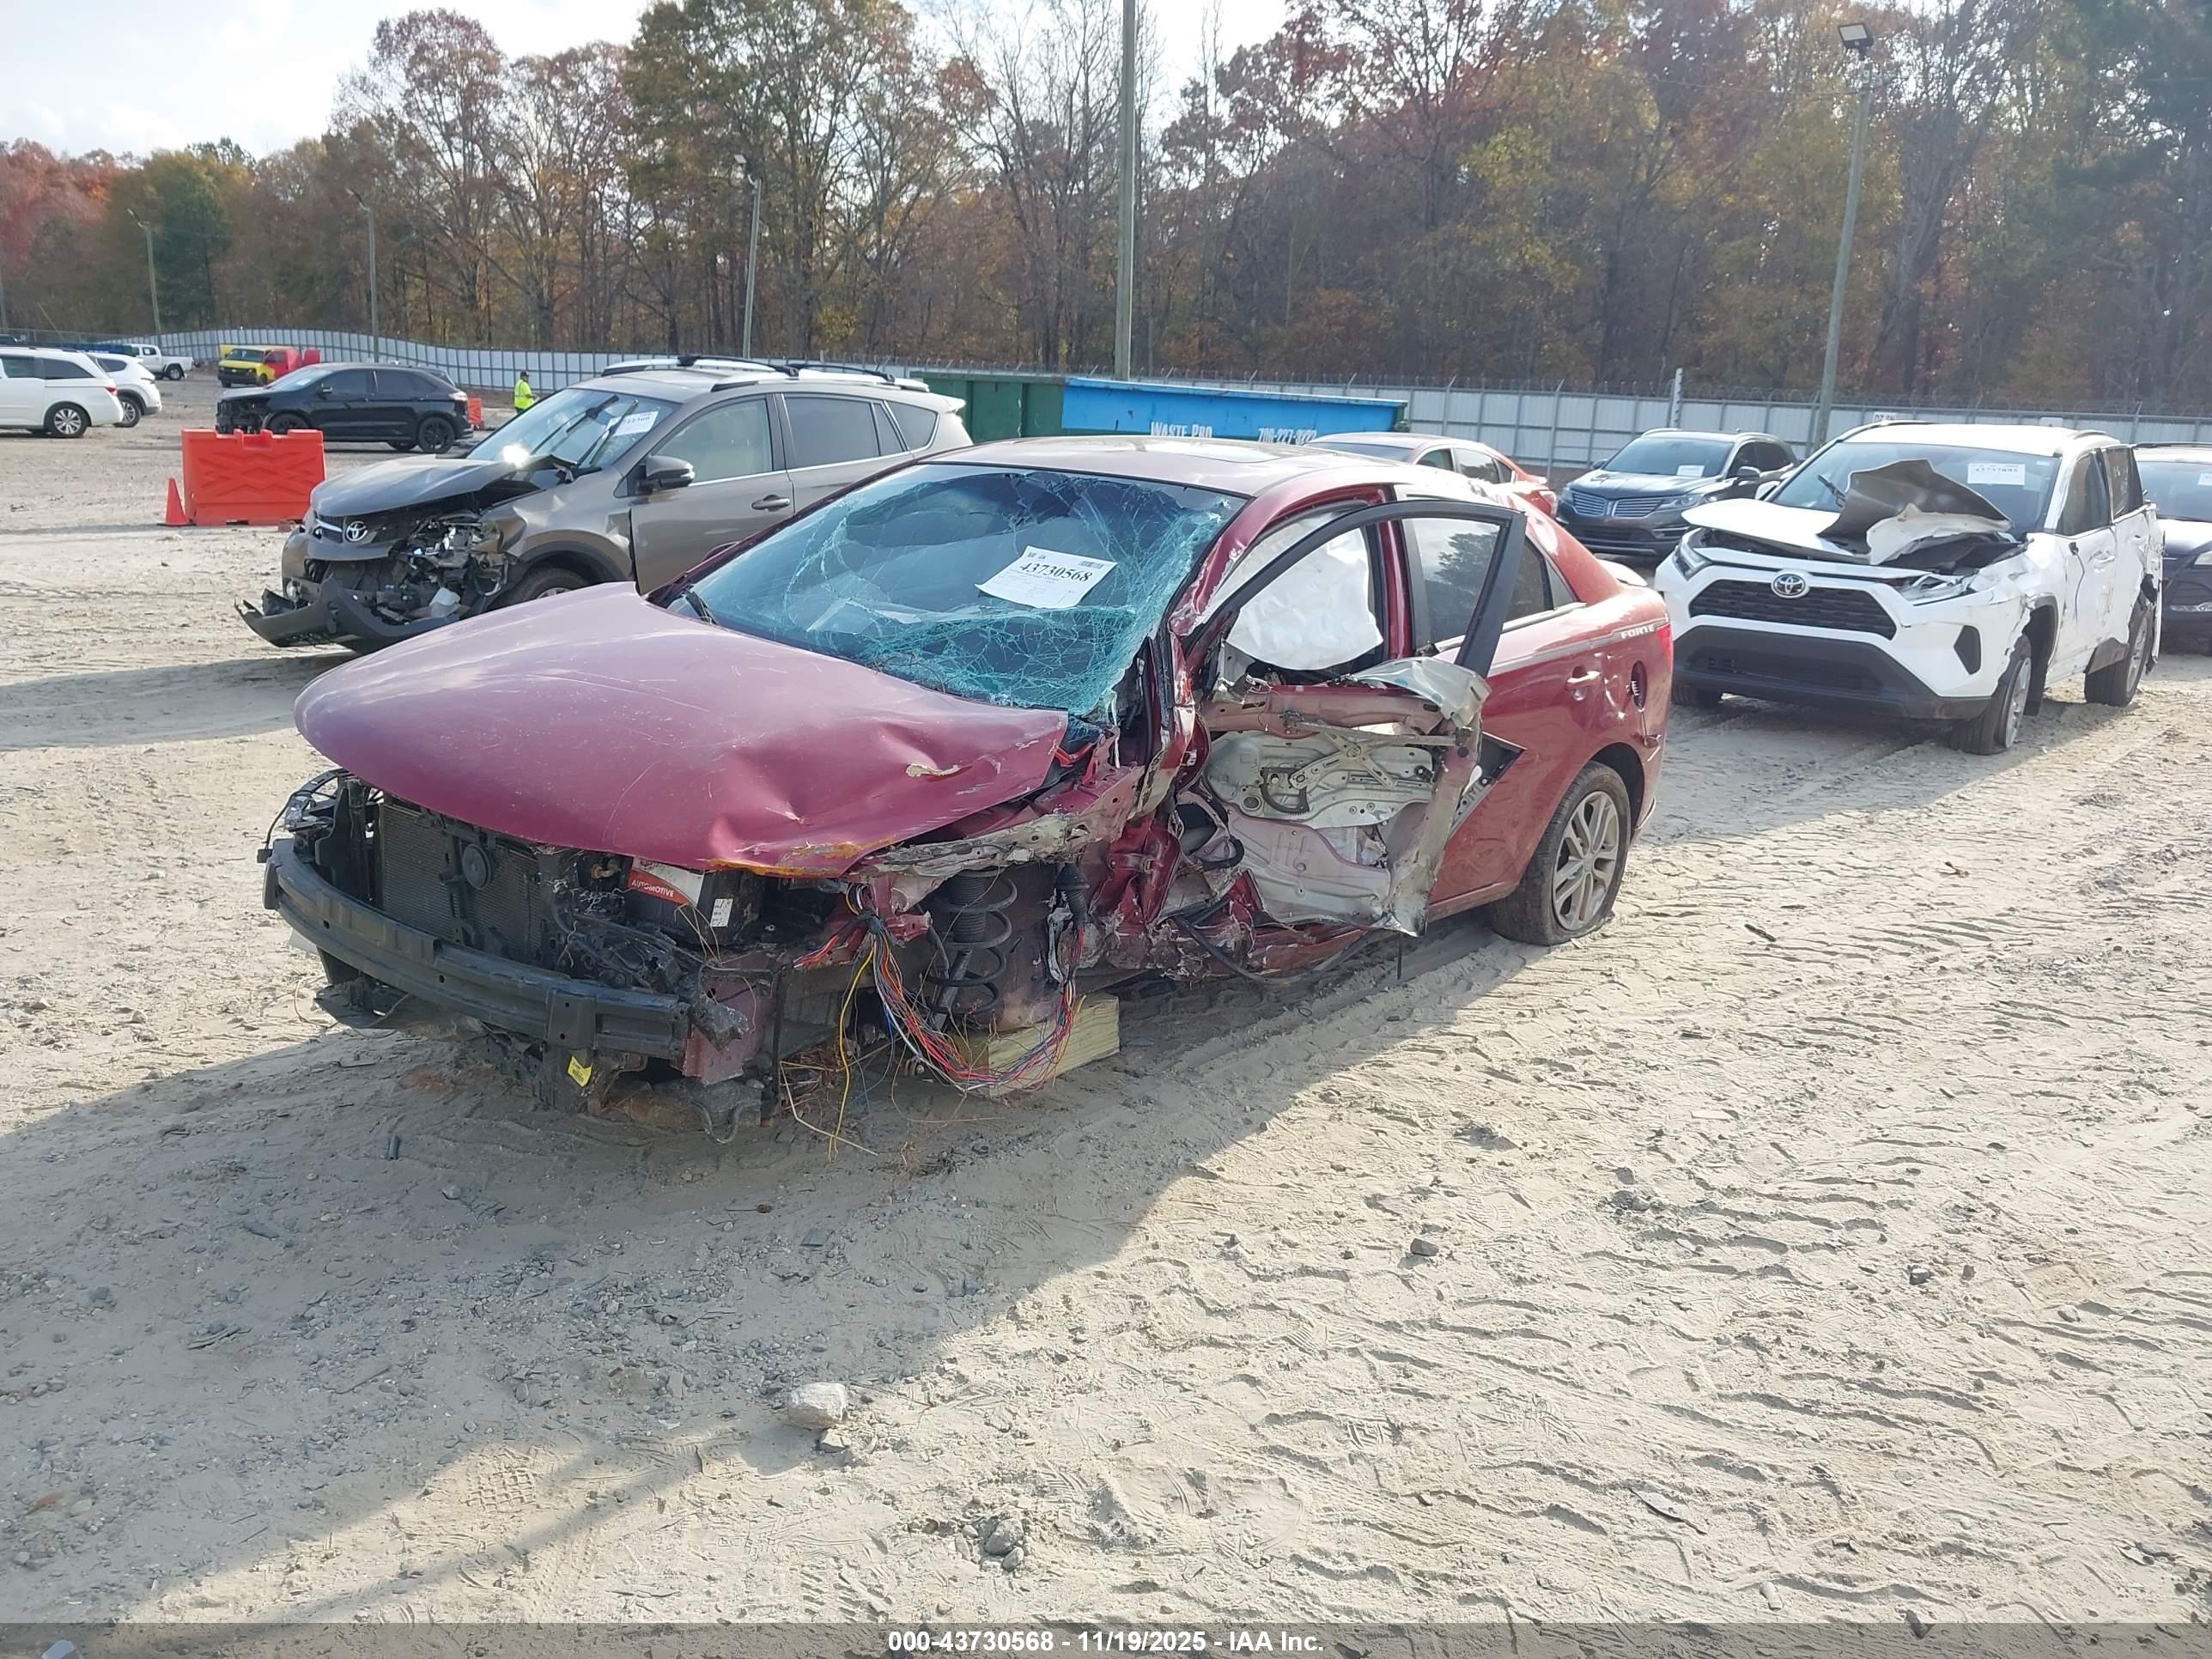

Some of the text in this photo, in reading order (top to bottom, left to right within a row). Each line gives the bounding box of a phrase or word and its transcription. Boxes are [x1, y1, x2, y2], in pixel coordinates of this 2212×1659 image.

[1019, 562, 1093, 582] 43730568
[1620, 623, 1656, 639] FORTE
[631, 879, 675, 897] AUTOMOTIVE
